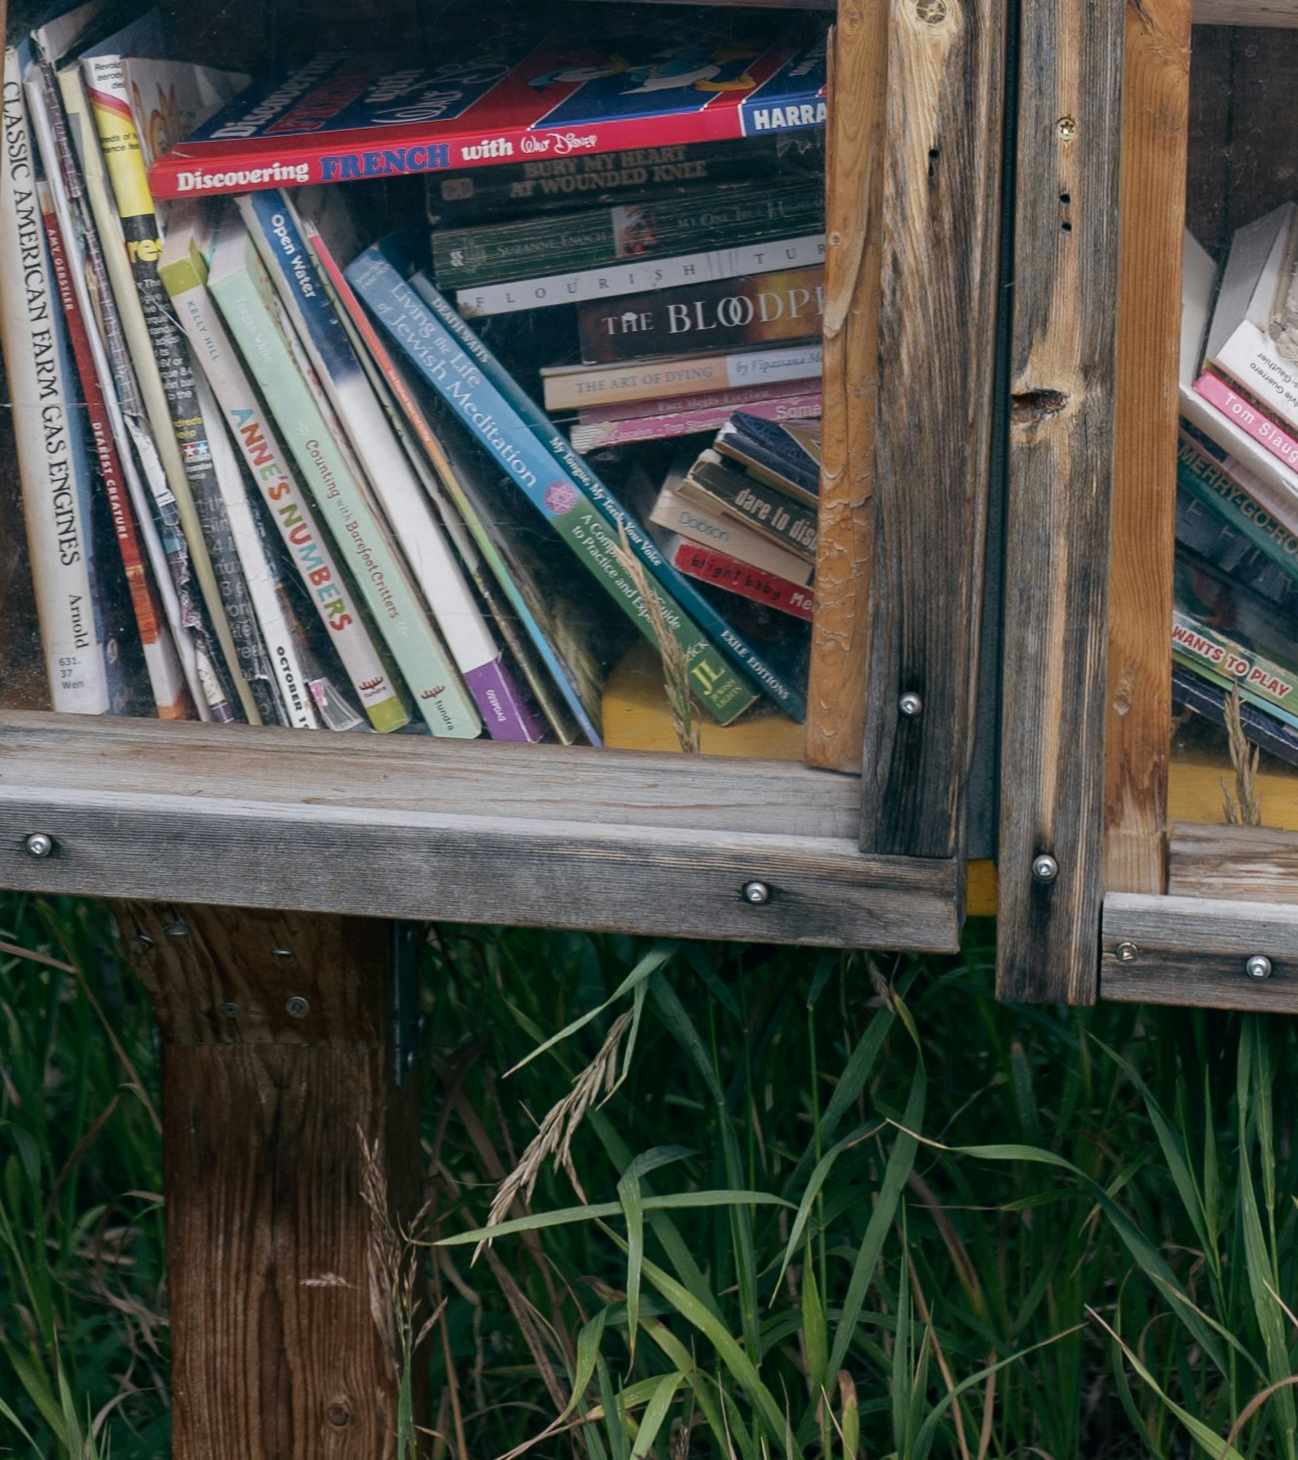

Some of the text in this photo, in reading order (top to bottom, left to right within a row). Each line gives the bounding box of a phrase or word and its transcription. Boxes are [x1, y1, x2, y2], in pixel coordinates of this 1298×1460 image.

[177, 162, 310, 193] Discovering
[319, 142, 450, 182] FRENCH
[461, 137, 514, 162] with
[520, 135, 550, 155] Walt
[509, 160, 708, 198] AT WOUNDED KNEE
[525, 145, 687, 178] BURY MY HEART
[270, 213, 317, 299] Open Water
[475, 263, 696, 309] FLOURISH
[2, 81, 81, 568] CLASSIC AMERICAN FARM GAS ENGINES
[390, 281, 437, 338] Living
[433, 336, 452, 355] the
[449, 352, 481, 389] Life
[377, 302, 394, 315] of
[390, 313, 449, 381] Jewish
[446, 379, 539, 488] Meditation
[1222, 392, 1254, 427] Tom
[91, 422, 129, 541] DEAREST CREATURE
[734, 488, 791, 531] dare to
[230, 407, 354, 633] ANNE'S NUMBERS
[68, 593, 90, 650] Arnold
[276, 645, 303, 713] OCTOBER
[719, 629, 792, 702] EXILE EDITIONS
[1172, 627, 1293, 700] WANTS TO PLAY
